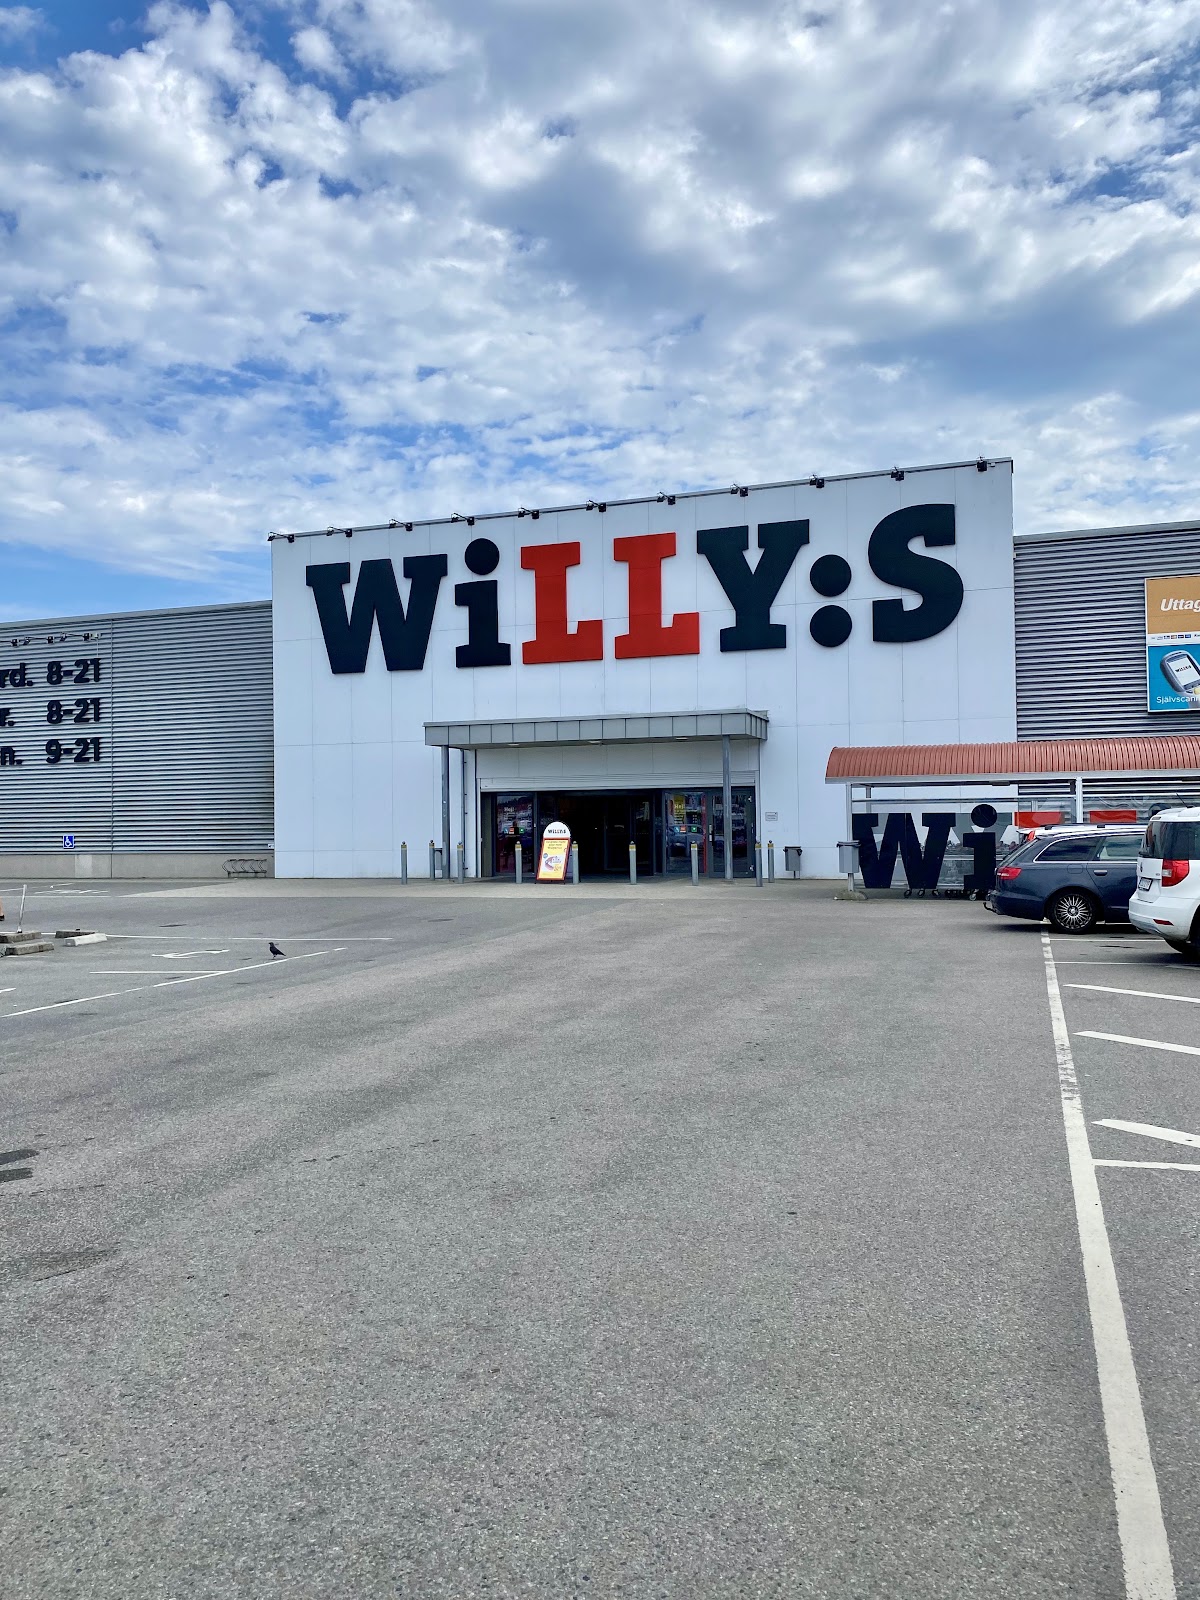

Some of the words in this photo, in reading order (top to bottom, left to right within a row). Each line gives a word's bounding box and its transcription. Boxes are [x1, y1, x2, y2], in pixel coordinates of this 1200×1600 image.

[47, 658, 101, 685] 8-21
[47, 698, 101, 724] 8-21
[46, 736, 101, 763] 9-21
